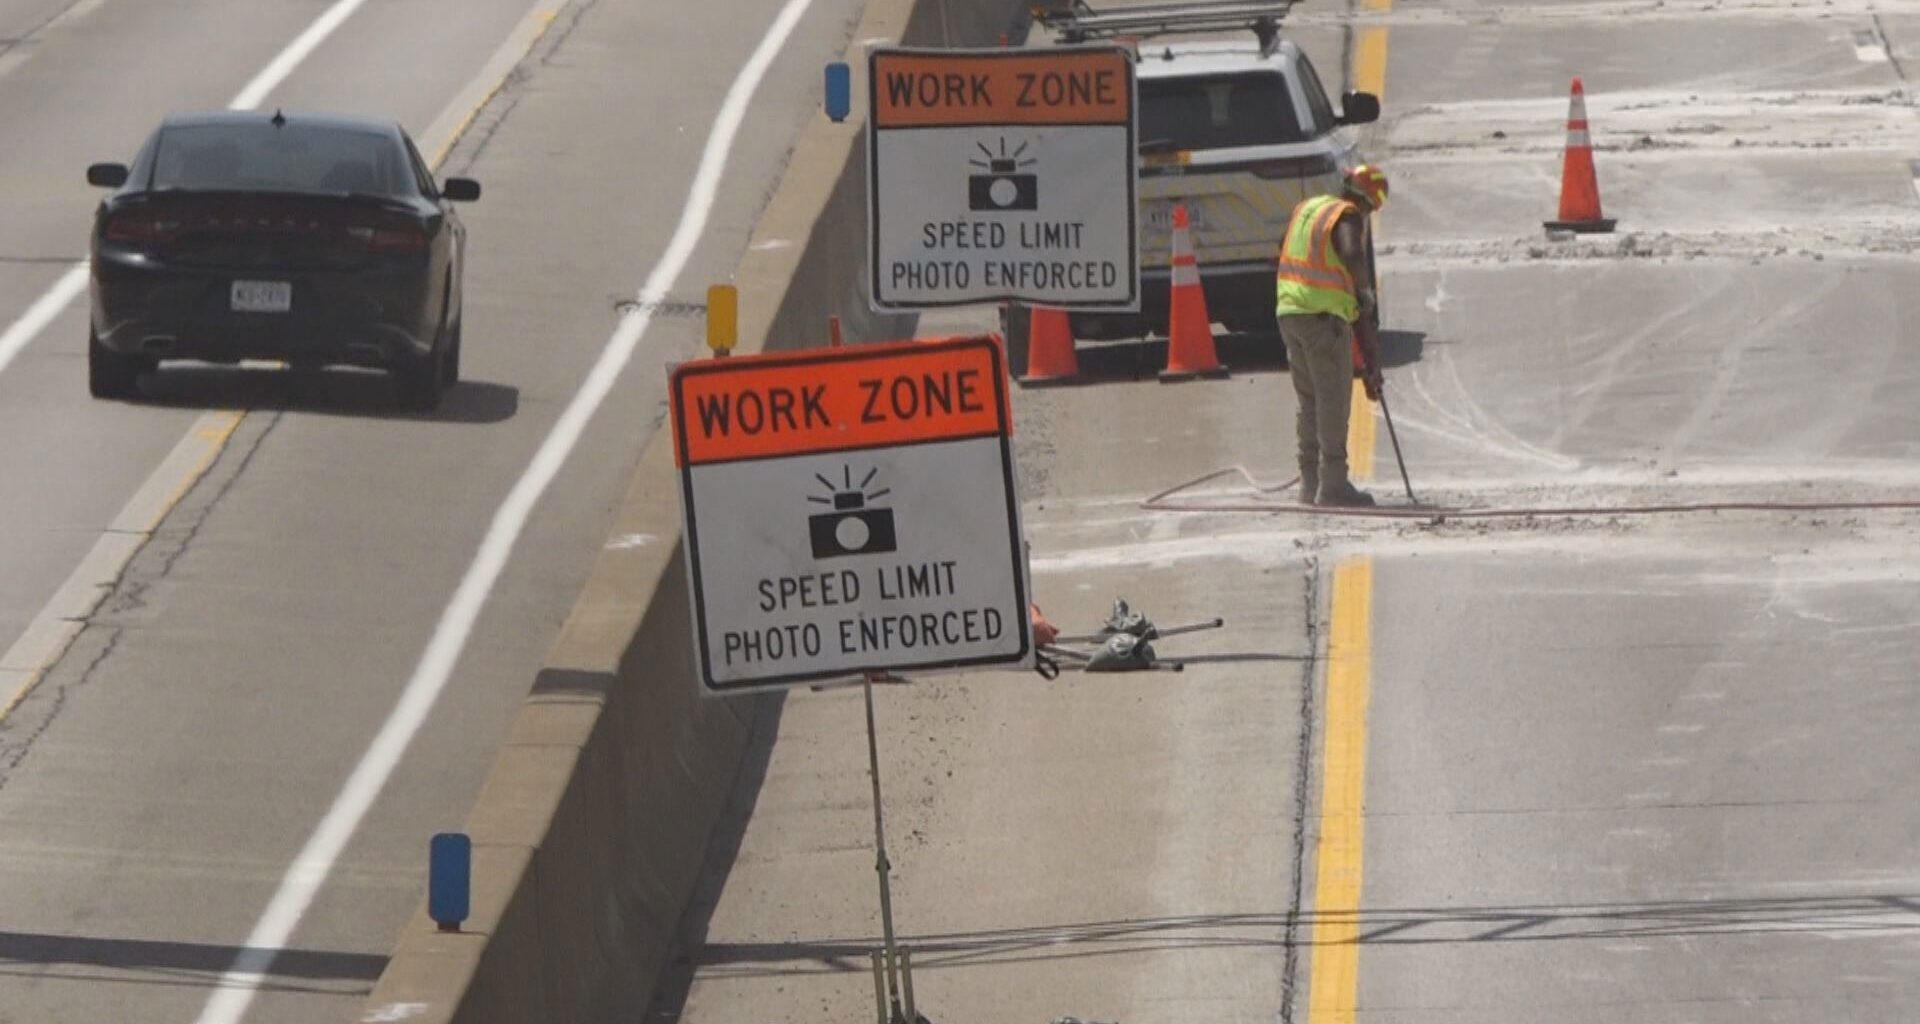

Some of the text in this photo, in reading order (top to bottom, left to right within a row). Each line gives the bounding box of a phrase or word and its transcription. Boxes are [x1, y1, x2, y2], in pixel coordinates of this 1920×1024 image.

[887, 71, 1116, 107] WORK ZONE
[922, 222, 1084, 249] SPEED LIMIT
[892, 261, 1116, 289] PHOTO ENFORCED
[697, 370, 983, 439] WORK ZONE
[758, 561, 957, 612] SPEED LIMIT
[724, 607, 1002, 665] PHOTO ENFORCED
